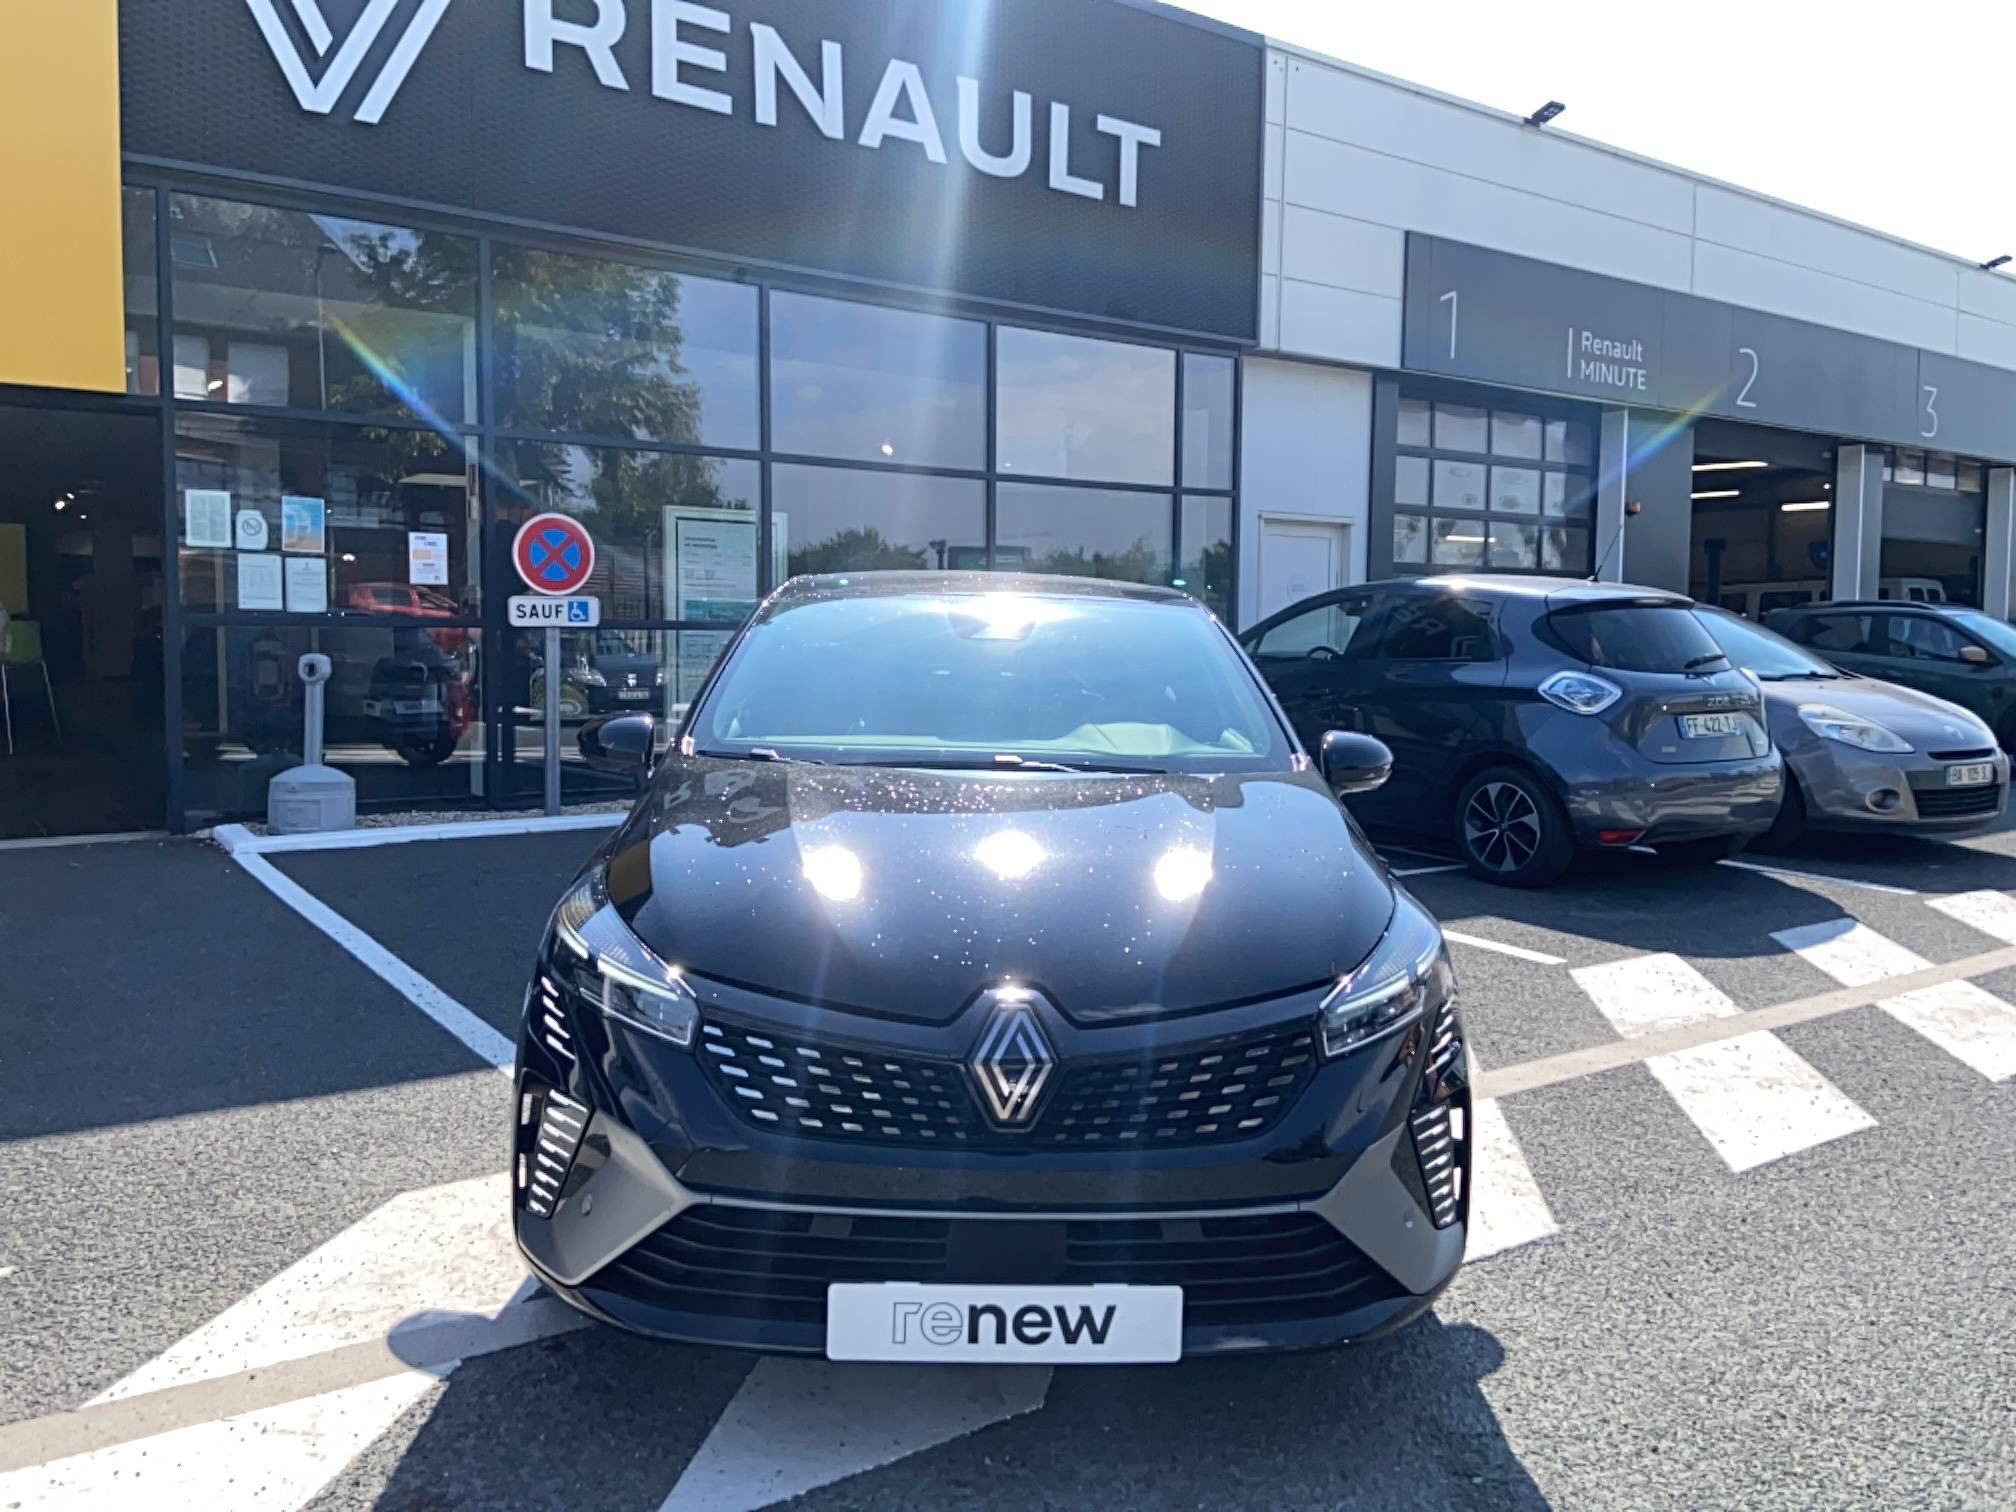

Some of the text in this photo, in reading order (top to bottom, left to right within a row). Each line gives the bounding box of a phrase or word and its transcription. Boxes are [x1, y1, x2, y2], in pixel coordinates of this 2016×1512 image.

[523, 0, 1161, 208] RENAULT
[1439, 290, 1457, 360] 1
[1581, 330, 1644, 363] Renault
[1580, 359, 1647, 390] MINUTE
[1736, 347, 1759, 408] 2
[1921, 385, 1938, 438] 3
[516, 603, 564, 619] SAUF
[892, 1301, 1117, 1346] renew
